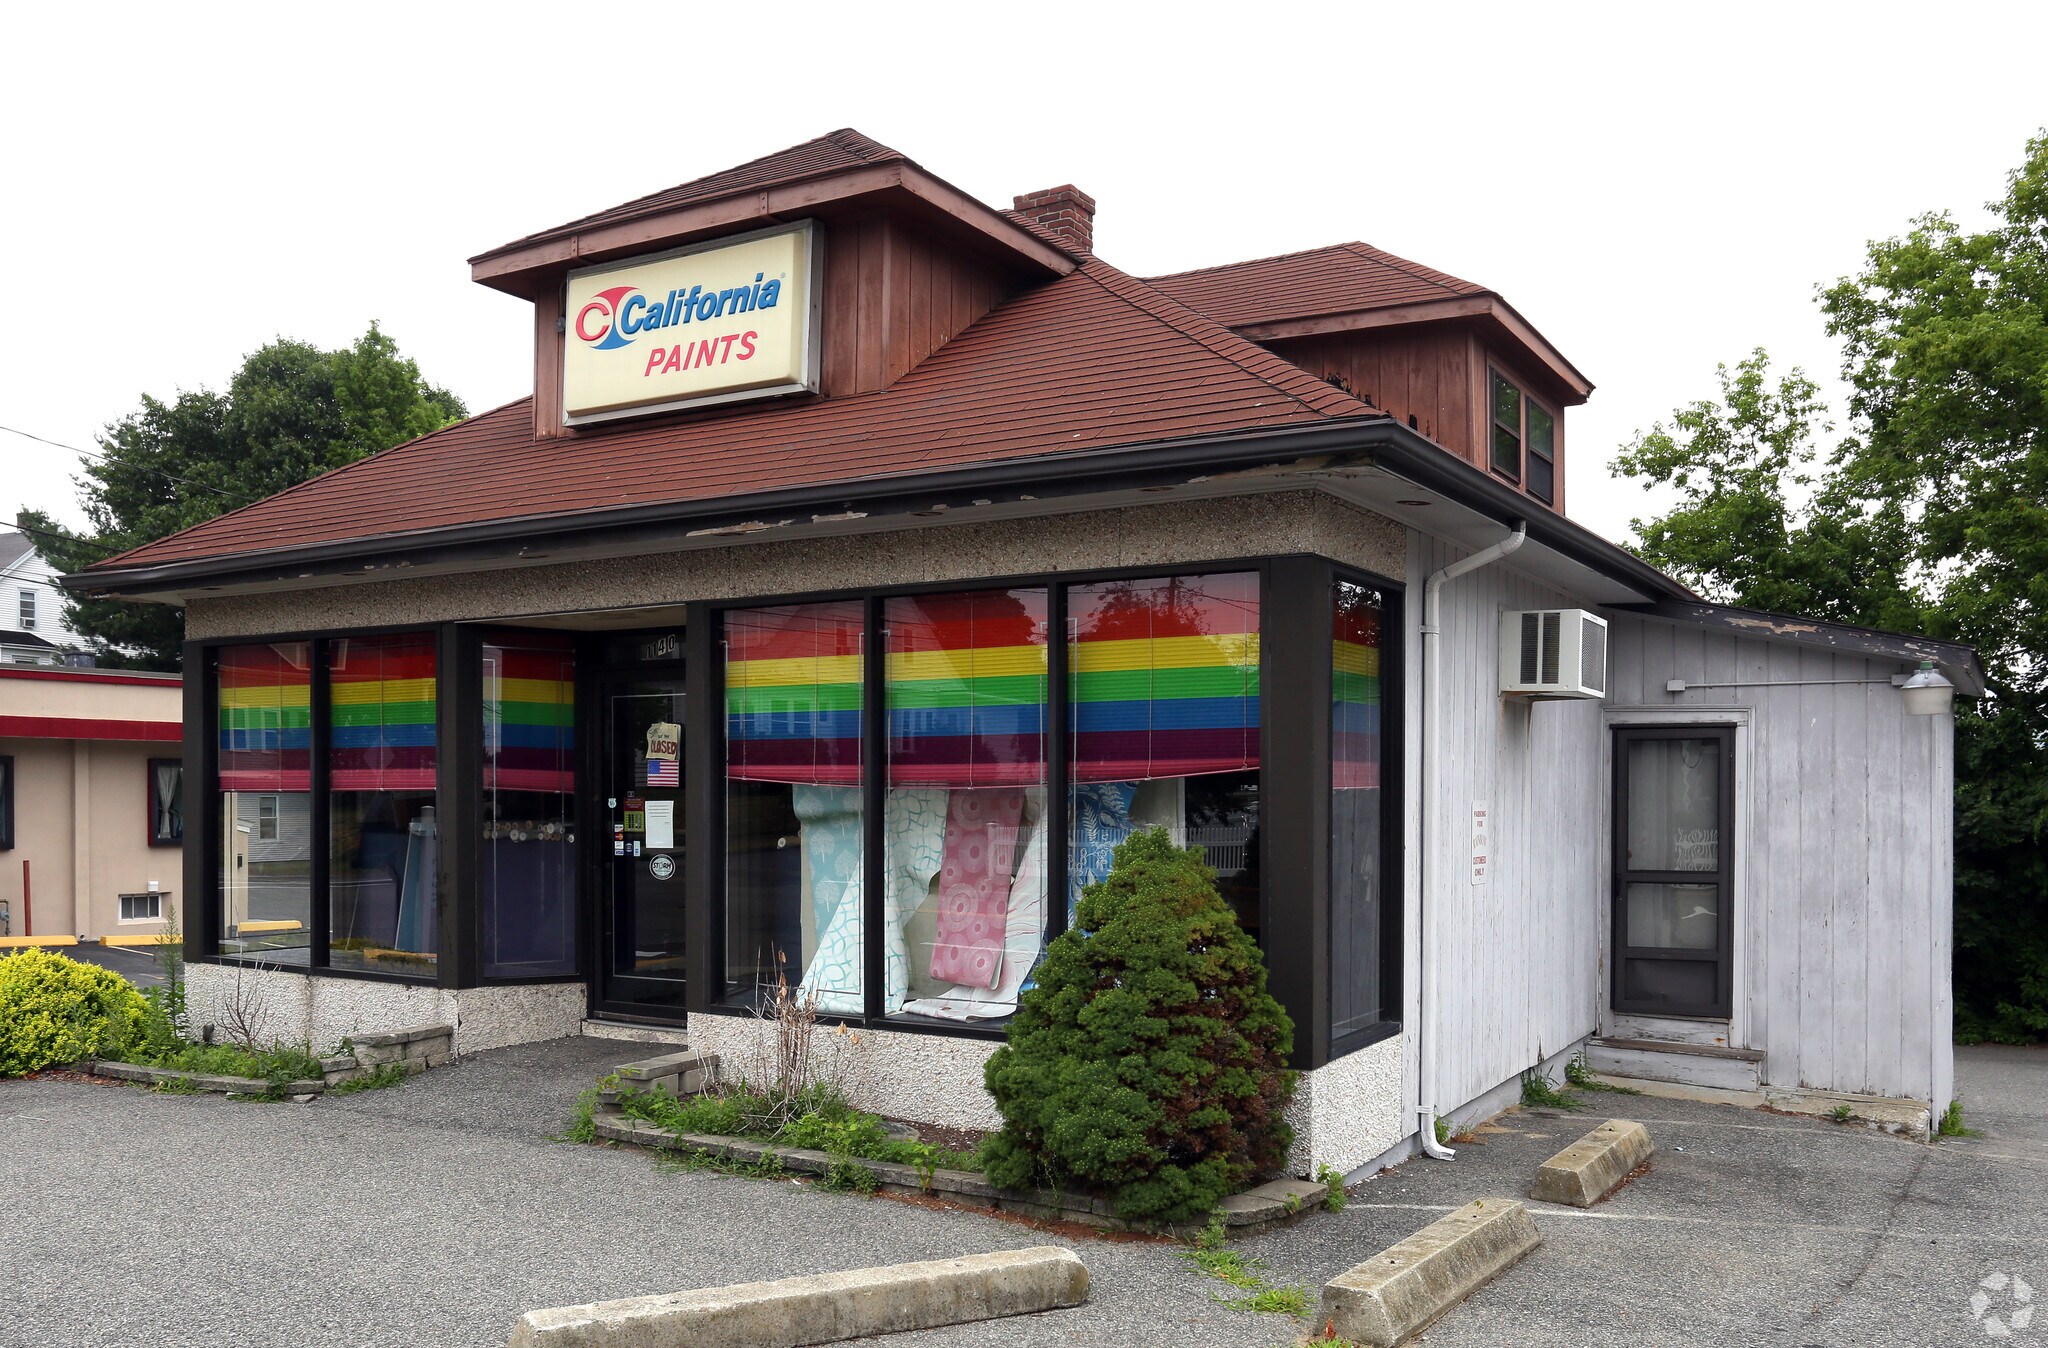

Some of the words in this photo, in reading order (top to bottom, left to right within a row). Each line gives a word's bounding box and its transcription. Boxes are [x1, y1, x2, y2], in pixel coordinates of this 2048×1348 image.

[620, 272, 782, 335] California
[644, 330, 759, 377] PAINTS
[647, 635, 675, 659] 1140
[650, 739, 678, 755] CLOSED
[1474, 868, 1484, 876] ONLY
